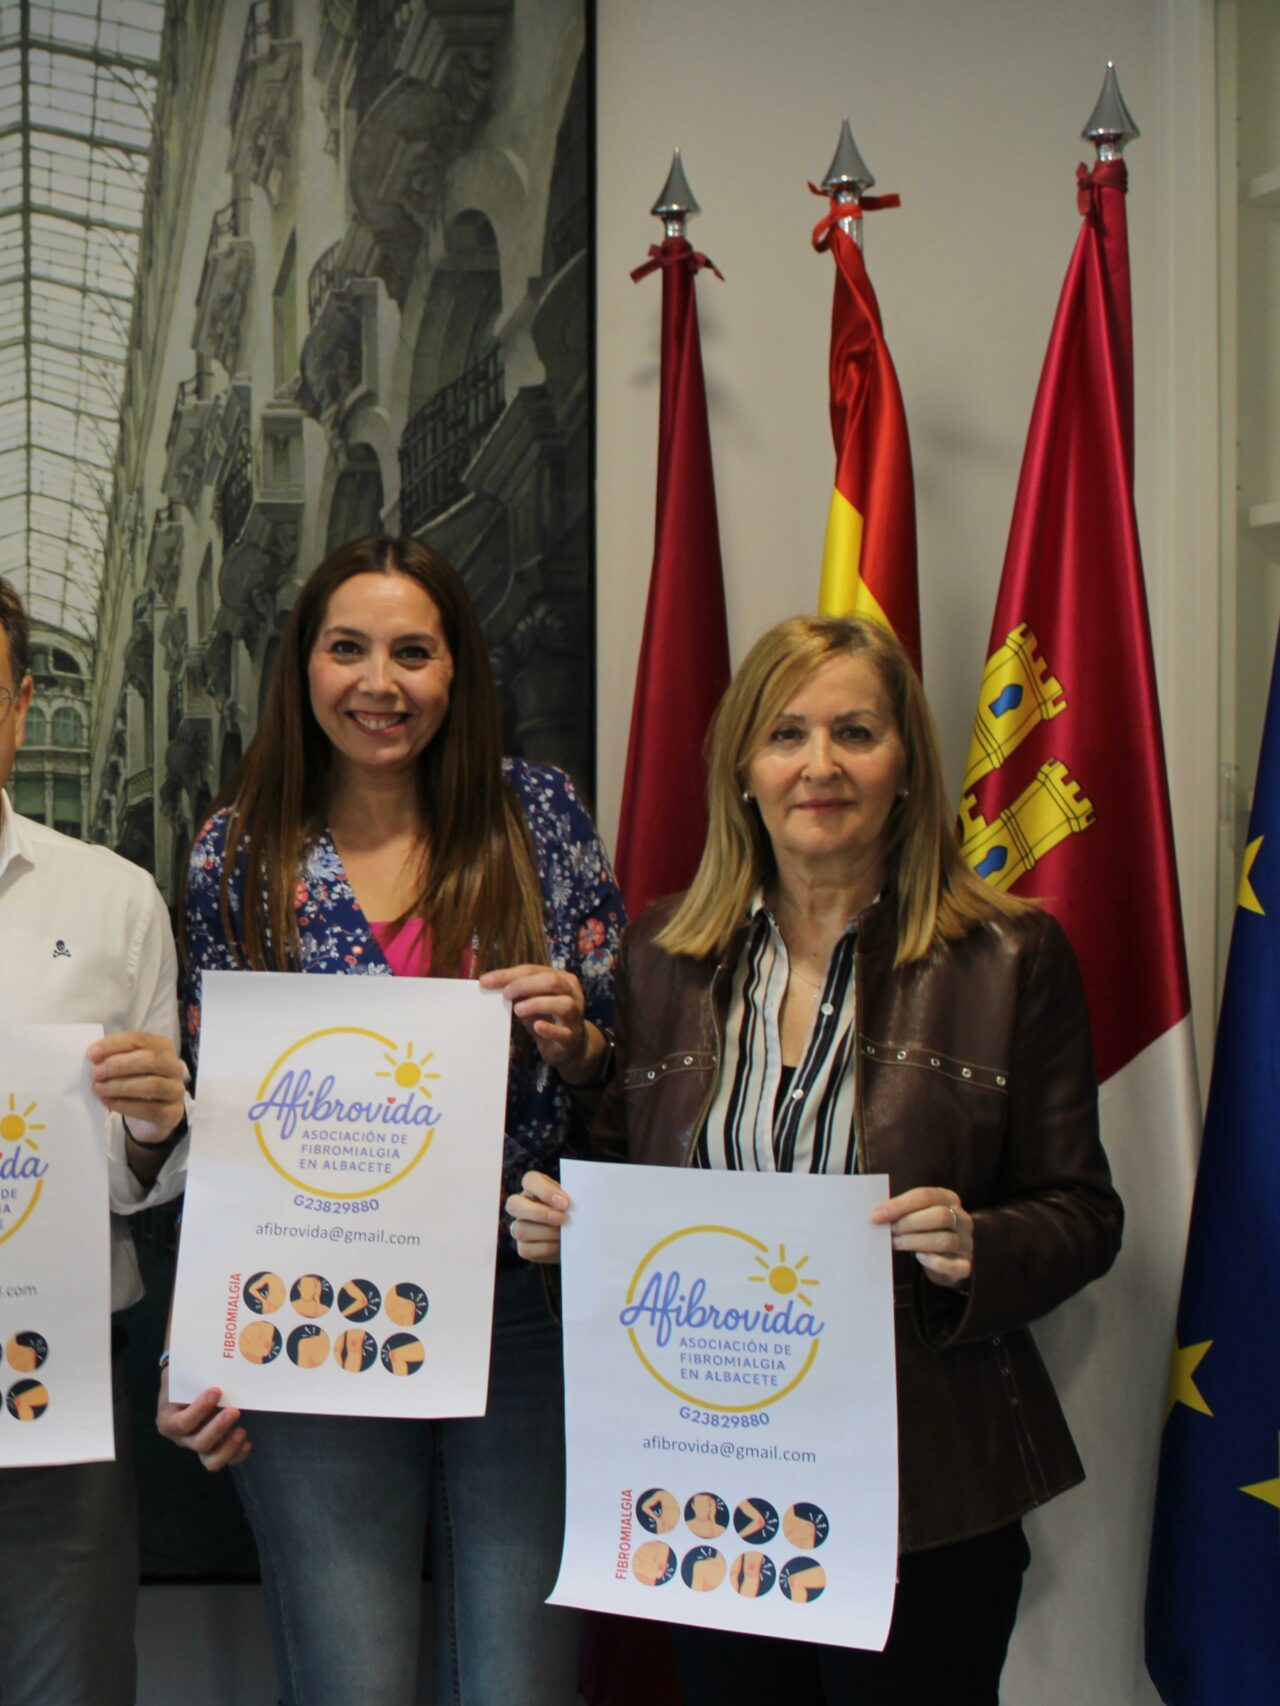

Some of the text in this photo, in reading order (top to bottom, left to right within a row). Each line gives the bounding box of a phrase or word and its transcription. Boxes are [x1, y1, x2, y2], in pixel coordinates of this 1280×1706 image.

[248, 1069, 441, 1140] Afibrovida
[302, 1129, 408, 1144] ASOCIACIÓN DE
[301, 1144, 401, 1159] FIBROMIALGIA
[299, 1159, 392, 1174] EN ALBACETE
[1, 1189, 17, 1199] DE
[293, 1194, 379, 1214] G23829880
[255, 1222, 421, 1246] afibrovida@gmail.com
[223, 1273, 242, 1359] FIBROMIALGIA
[620, 1271, 825, 1347] Afibrovida
[679, 1337, 792, 1355] ASOCIACIÓN DE
[680, 1353, 786, 1370] FIBROMIALGIA
[681, 1369, 778, 1386] EN ALBACETE
[679, 1406, 770, 1428] G23829880
[642, 1435, 816, 1463] afibrovida@gmail.com
[615, 1489, 633, 1580] FIBROMIALGIA
